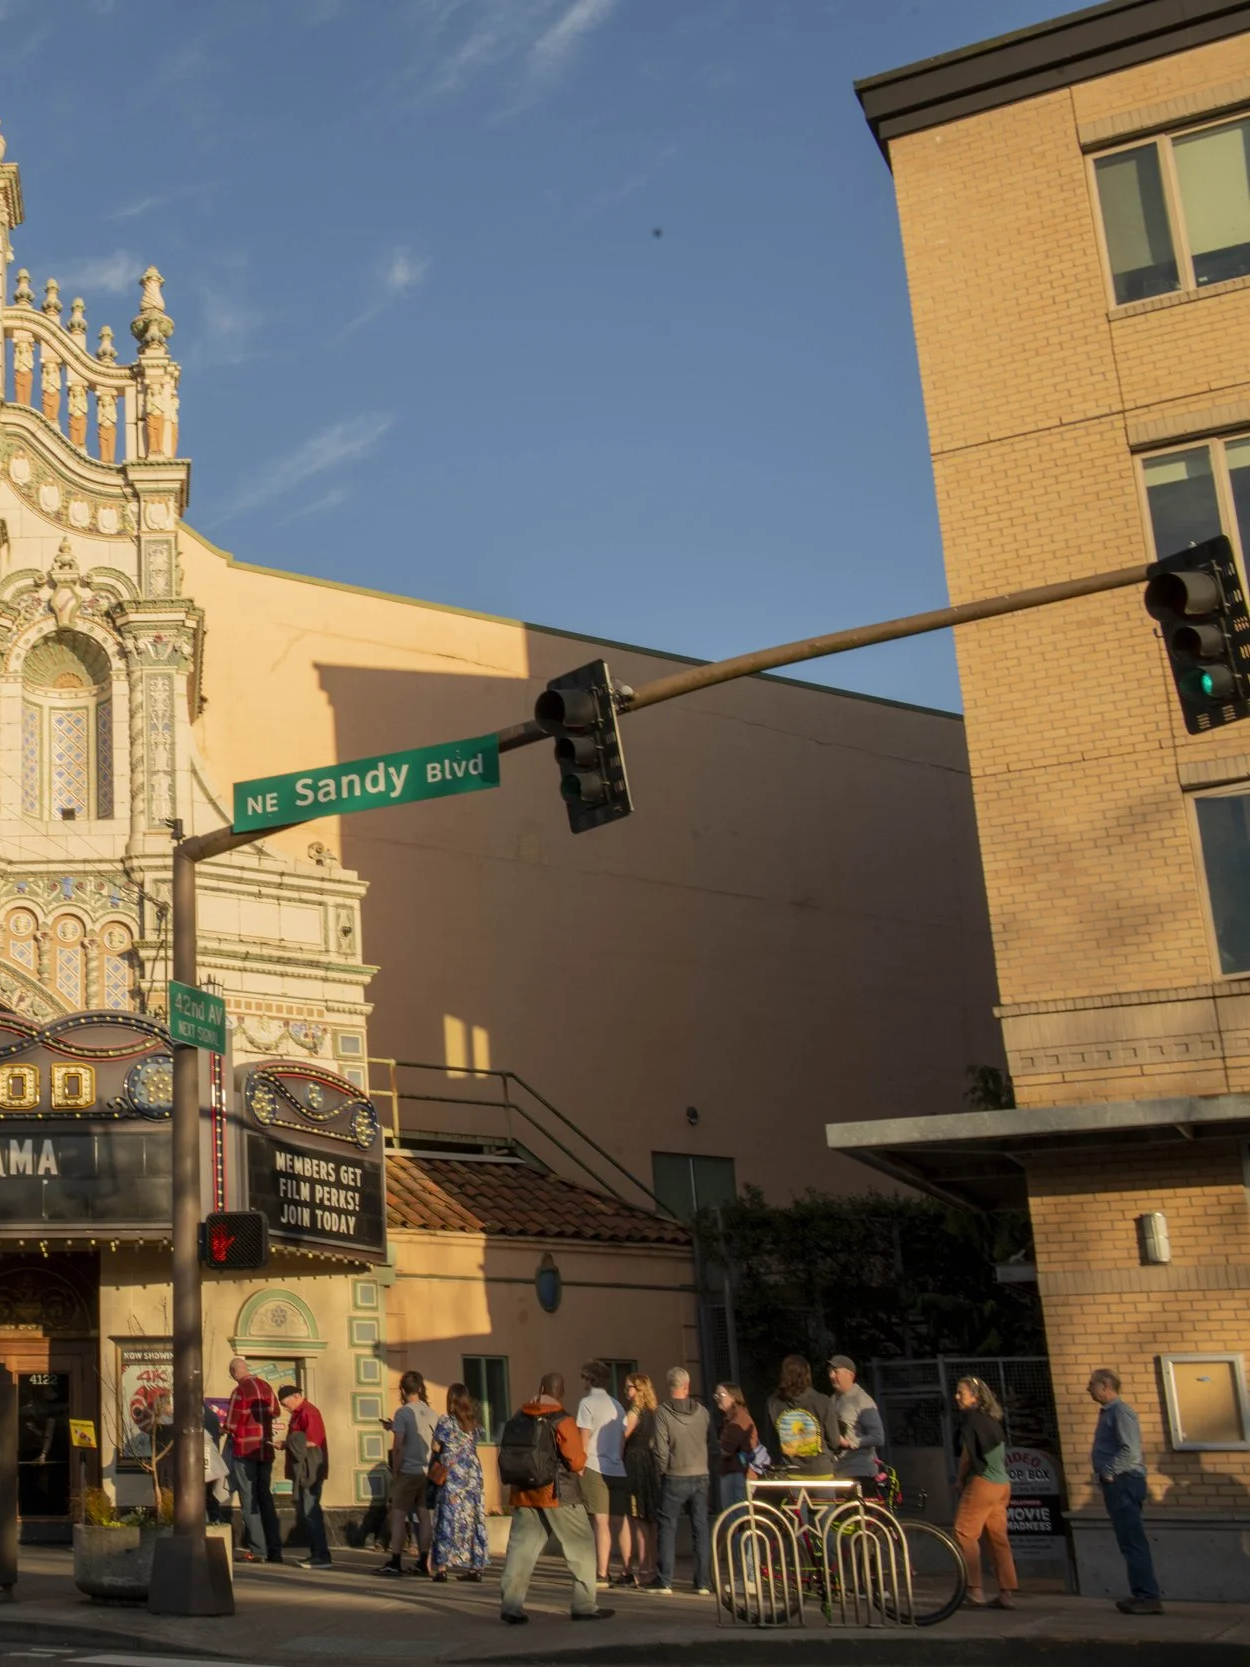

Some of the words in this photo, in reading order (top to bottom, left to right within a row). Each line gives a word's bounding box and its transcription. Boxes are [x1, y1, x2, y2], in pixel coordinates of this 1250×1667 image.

[246, 792, 279, 816] NE
[294, 761, 410, 807] Sandy
[425, 753, 484, 784] Blvd
[175, 992, 205, 1022] 42nd
[208, 1003, 223, 1027] AV
[276, 1151, 335, 1182] MEMBERS
[340, 1165, 362, 1187] GET
[280, 1178, 310, 1202] FILM
[315, 1184, 359, 1211] PERKS!
[281, 1204, 310, 1228] JOIN
[315, 1209, 356, 1235] TODAY
[29, 1374, 58, 1385] 4122
[1027, 1469, 1050, 1482] BOX
